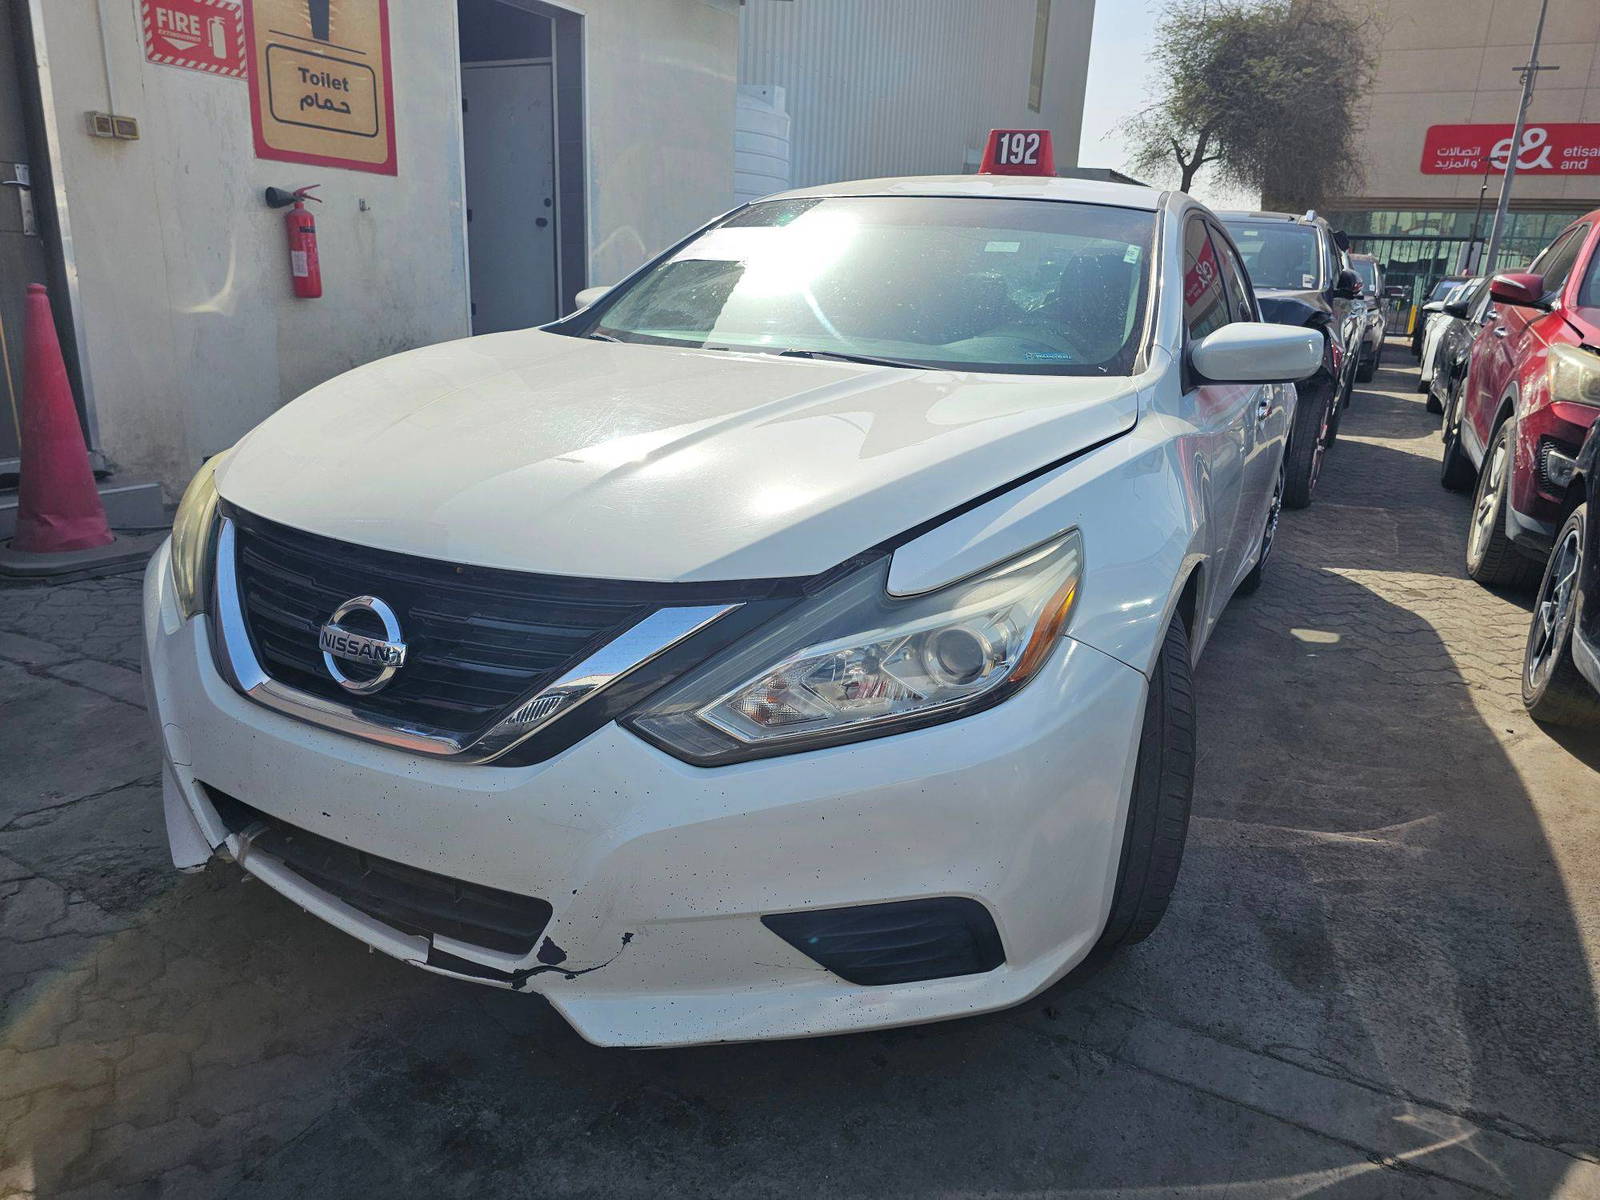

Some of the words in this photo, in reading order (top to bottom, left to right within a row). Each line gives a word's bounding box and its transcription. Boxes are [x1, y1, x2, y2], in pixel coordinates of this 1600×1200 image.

[156, 7, 201, 36] FIRE
[297, 66, 349, 92] Toilet
[300, 92, 351, 115] حمام
[1000, 133, 1040, 165] 192
[1436, 146, 1481, 156] اتصالات
[1560, 158, 1588, 170] and
[320, 630, 391, 662] NISSAN
